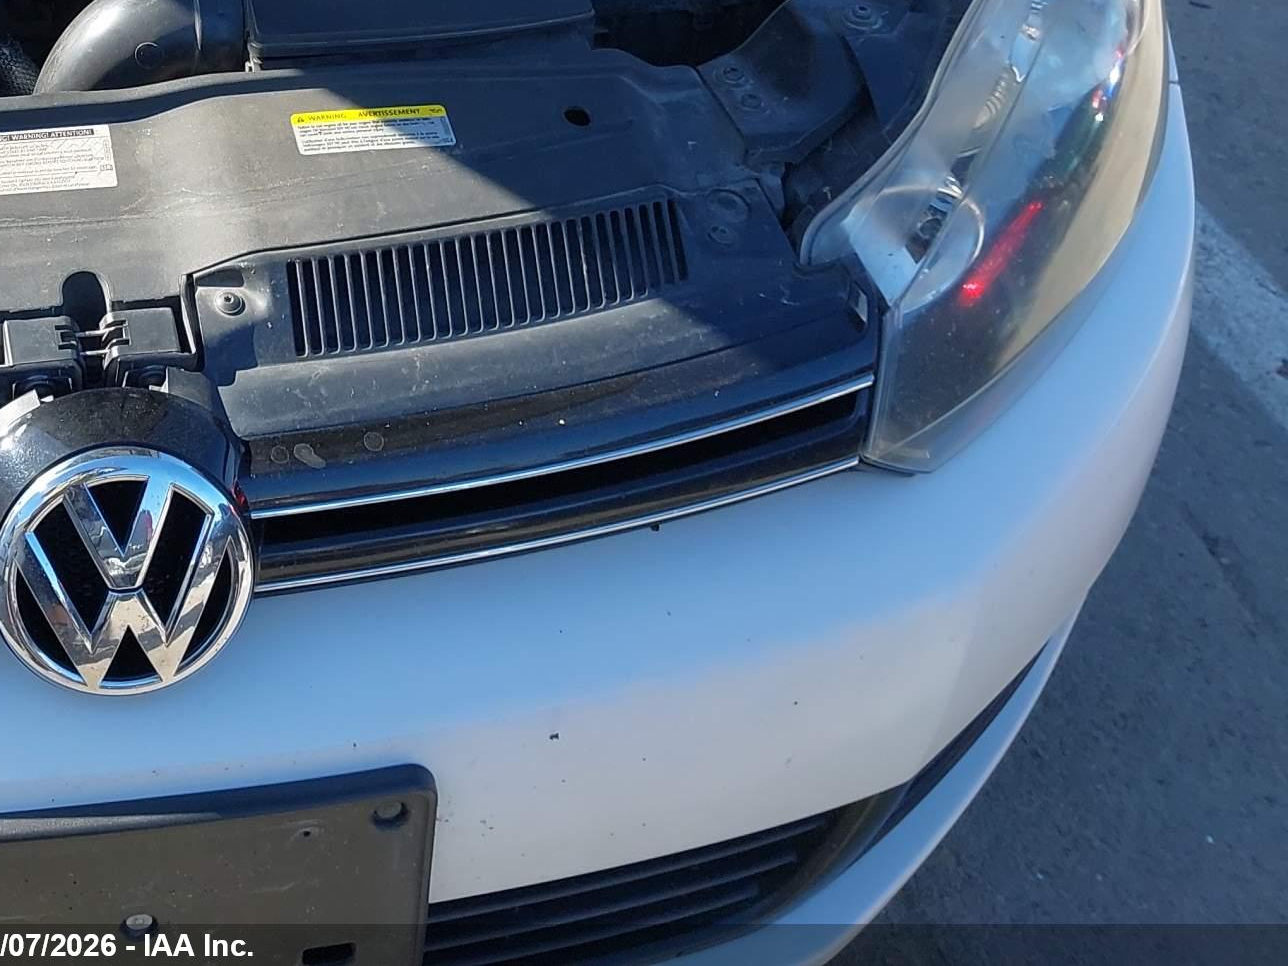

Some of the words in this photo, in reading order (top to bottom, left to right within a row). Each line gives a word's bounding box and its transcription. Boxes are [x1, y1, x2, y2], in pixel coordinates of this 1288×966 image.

[358, 108, 421, 118] AVERTISSEMENT
[11, 132, 49, 141] WARNING!
[50, 129, 92, 138] ATTENTION!
